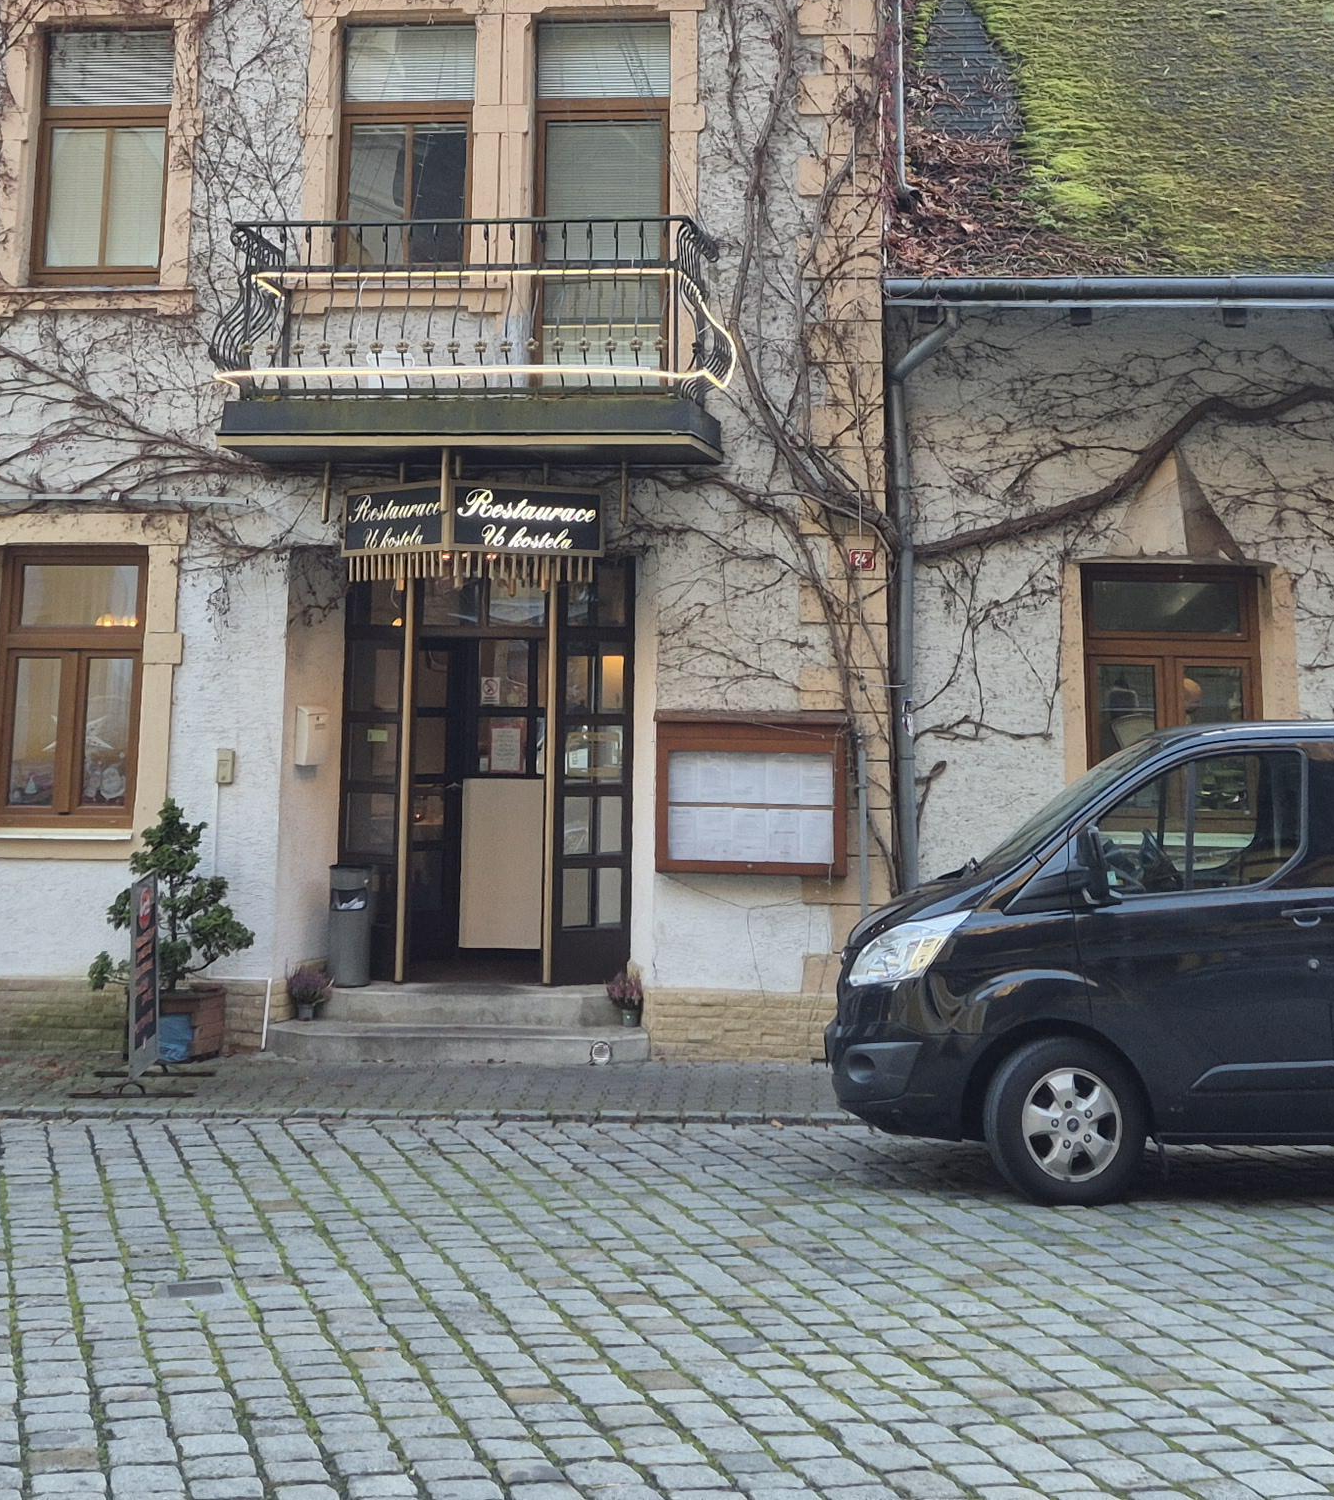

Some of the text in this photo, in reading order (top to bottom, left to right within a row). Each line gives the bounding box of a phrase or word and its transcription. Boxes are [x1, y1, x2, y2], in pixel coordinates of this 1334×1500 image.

[348, 494, 441, 523] Restaurace
[457, 488, 596, 523] Restaurace
[363, 524, 423, 549] U kostela
[481, 524, 573, 549] U kostela
